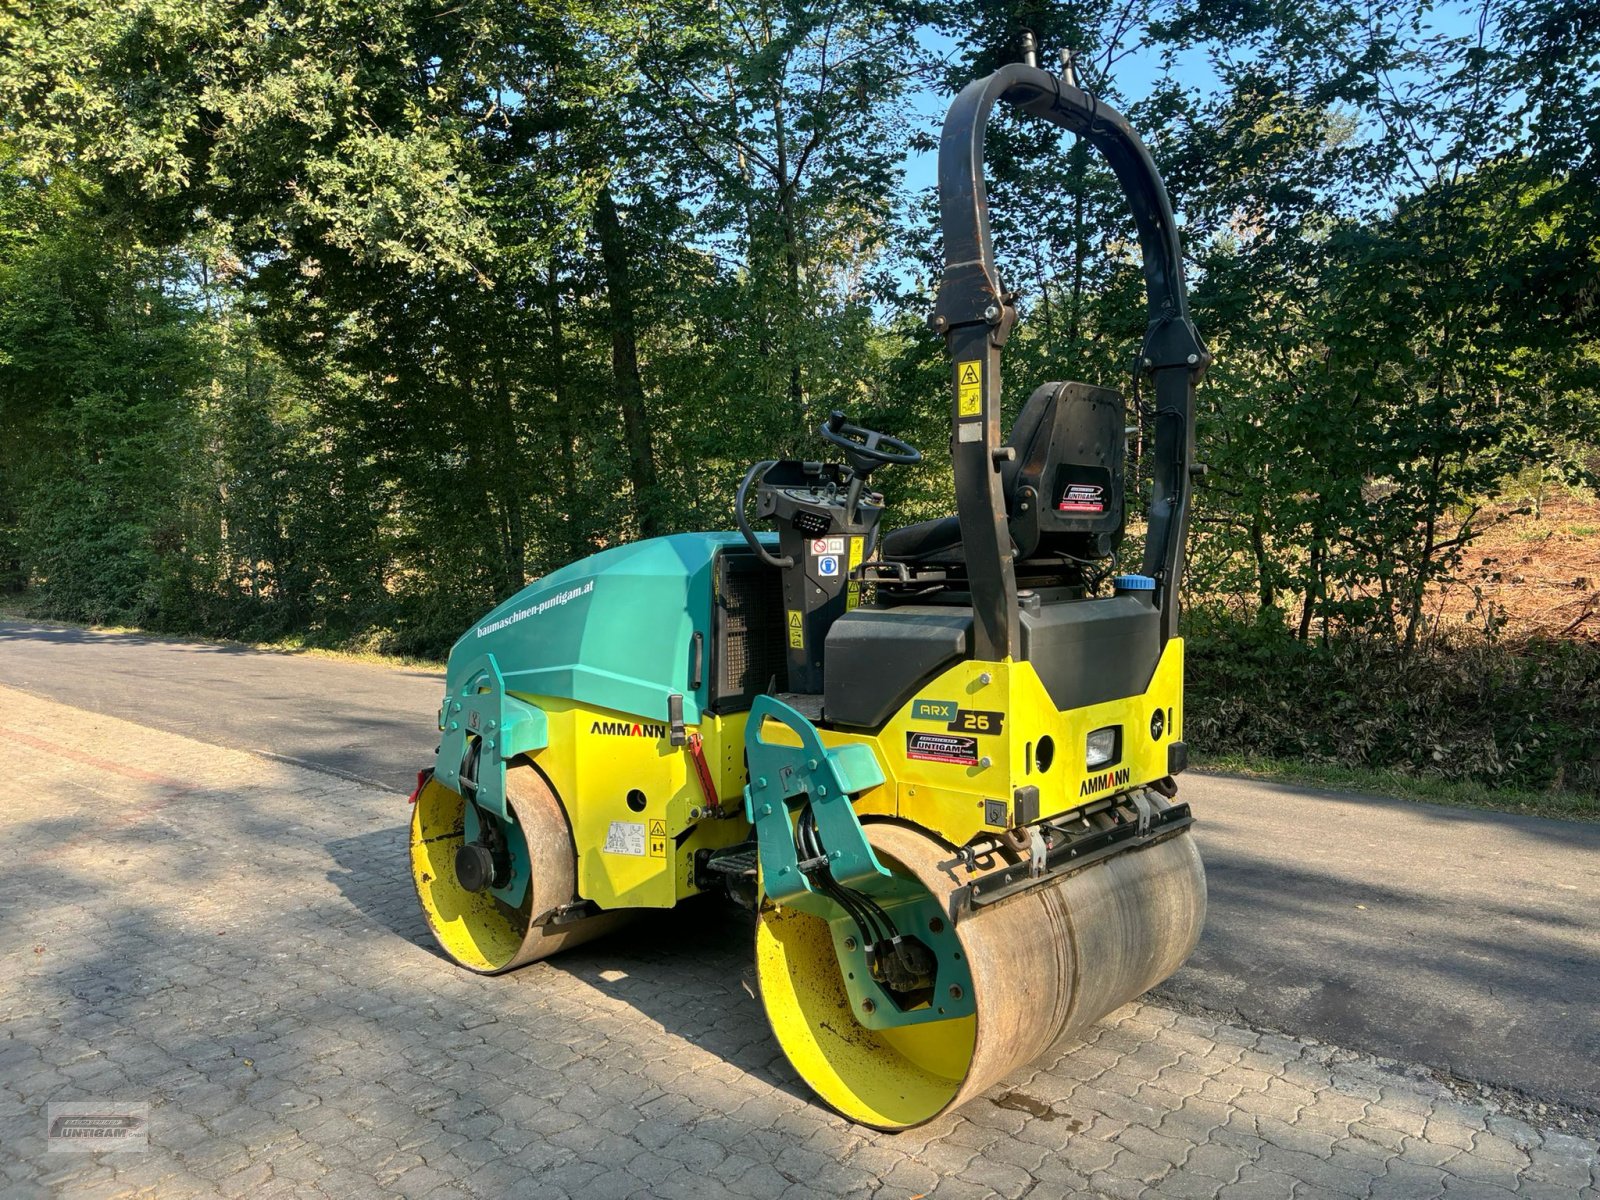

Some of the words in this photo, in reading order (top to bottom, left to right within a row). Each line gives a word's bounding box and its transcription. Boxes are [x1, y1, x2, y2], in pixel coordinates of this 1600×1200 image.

[477, 580, 594, 638] baumaschinen-puntigam.at
[920, 704, 949, 717] ARX
[590, 721, 666, 739] AMMANN
[964, 713, 990, 730] 26
[1079, 767, 1130, 797] AMMANN
